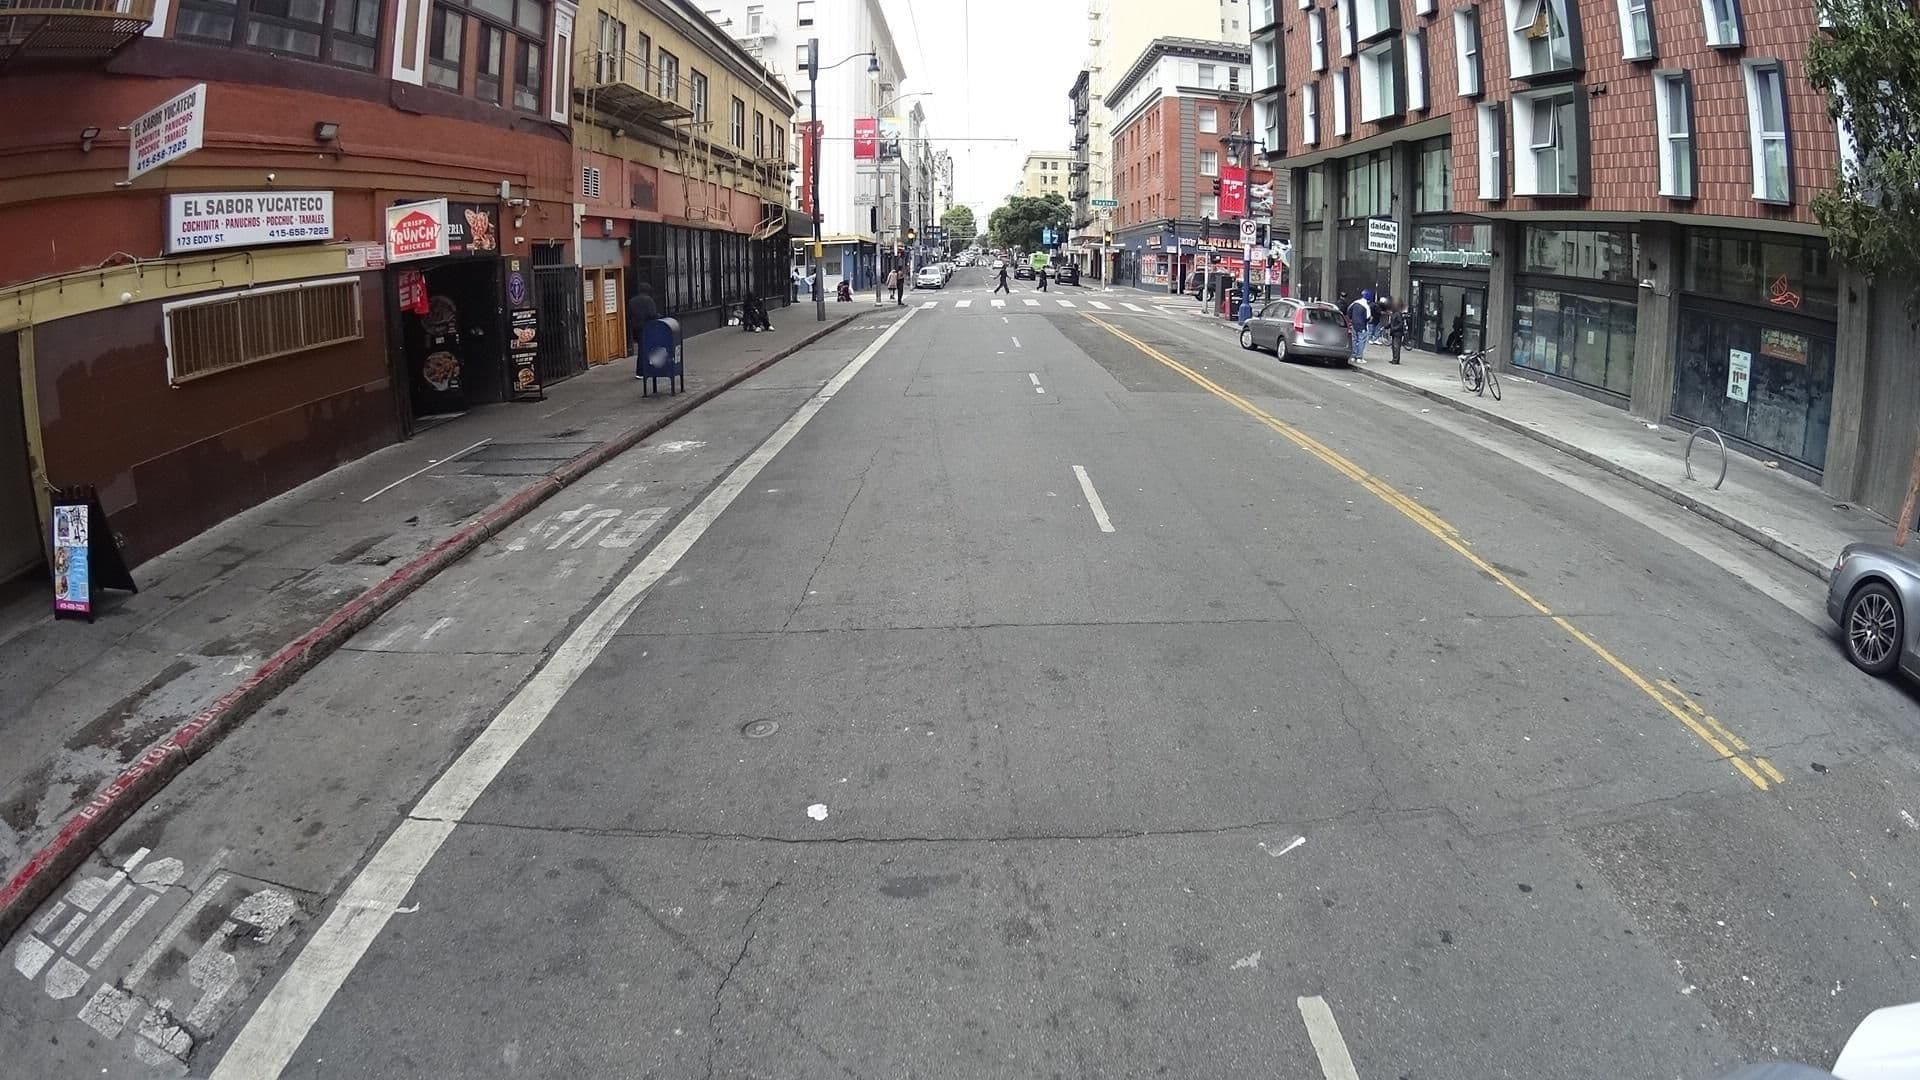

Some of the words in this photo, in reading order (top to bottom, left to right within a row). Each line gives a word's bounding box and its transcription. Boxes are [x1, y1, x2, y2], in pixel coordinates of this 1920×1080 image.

[134, 122, 141, 138] EL
[142, 110, 163, 133] SABOR
[163, 92, 197, 121] YUCATECO
[135, 128, 161, 149] COCHINITA
[164, 111, 193, 133] PANUCHOS
[164, 125, 188, 145] TAMALES
[137, 139, 188, 170] 415-658-7225
[184, 200, 202, 217] EL
[206, 198, 254, 215] SABOR
[257, 197, 323, 212] YUCATECO
[182, 219, 220, 233] COCHINITA
[225, 216, 261, 229] PANUCHOS
[266, 215, 294, 226] POCCHUC
[299, 214, 325, 225] TAMALES
[269, 226, 329, 238] 415-658-7225
[403, 218, 427, 228] KRISPY
[176, 236, 191, 246] 173
[193, 235, 212, 245] EDDY
[400, 241, 431, 252] CHICKEN
[1370, 240, 1396, 251] market
[79, 783, 122, 820] BUS
